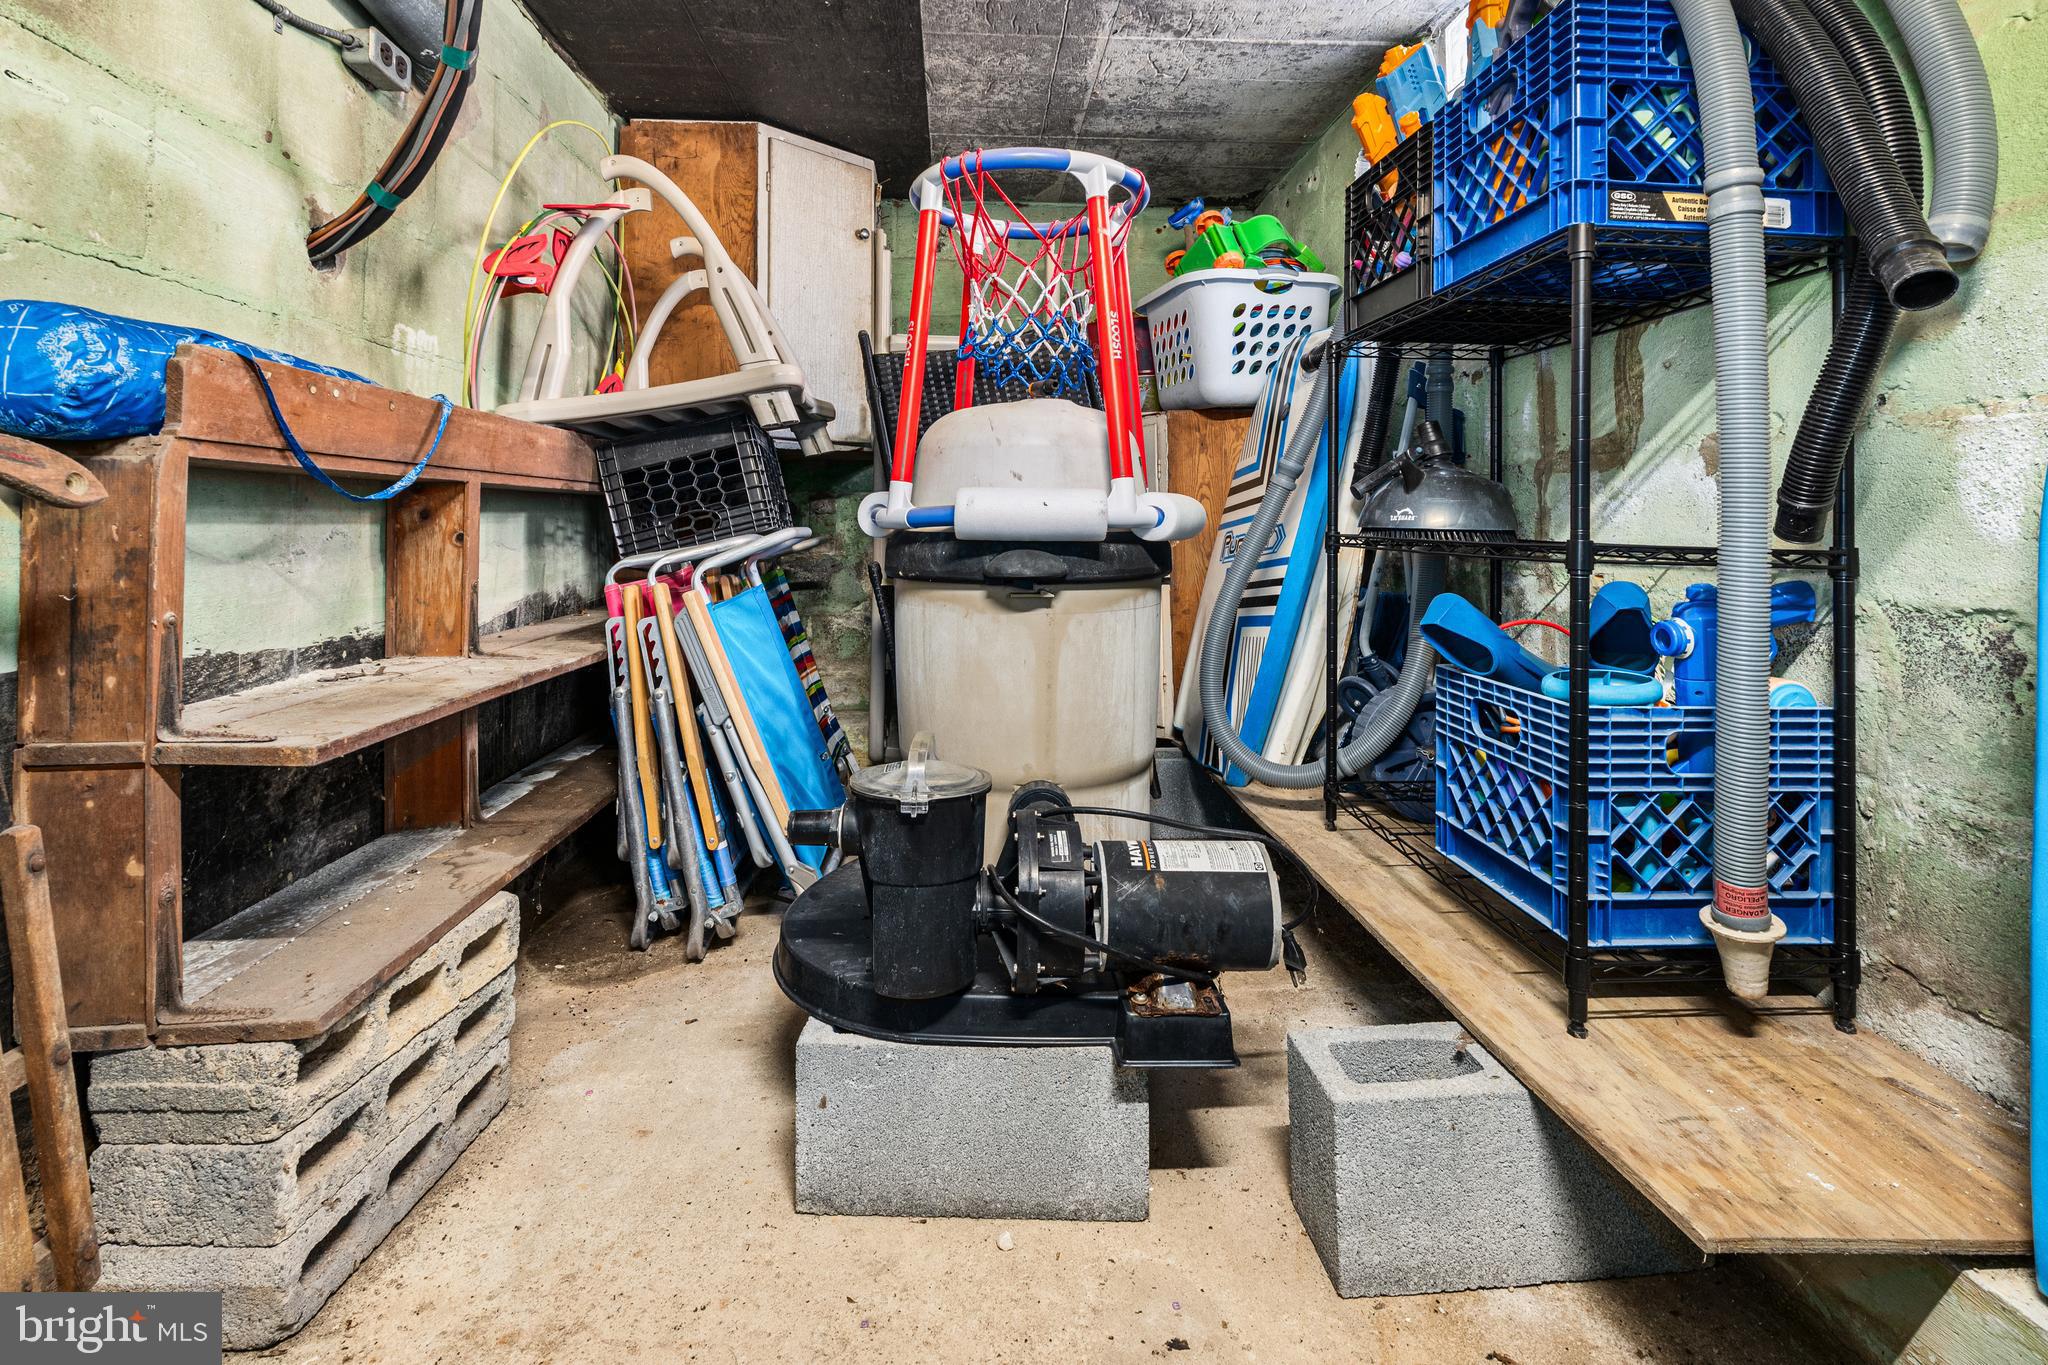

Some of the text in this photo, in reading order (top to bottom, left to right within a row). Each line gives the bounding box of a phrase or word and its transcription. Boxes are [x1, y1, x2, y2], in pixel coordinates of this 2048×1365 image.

[1613, 192, 1633, 200] GSC
[1672, 197, 1698, 205] Authentic
[1677, 205, 1696, 213] Caisse
[1683, 213, 1707, 221] Auténtic
[1110, 310, 1122, 360] SLOOSH
[1725, 892, 1760, 903] PELIGRO
[1725, 905, 1760, 917] DANGER
